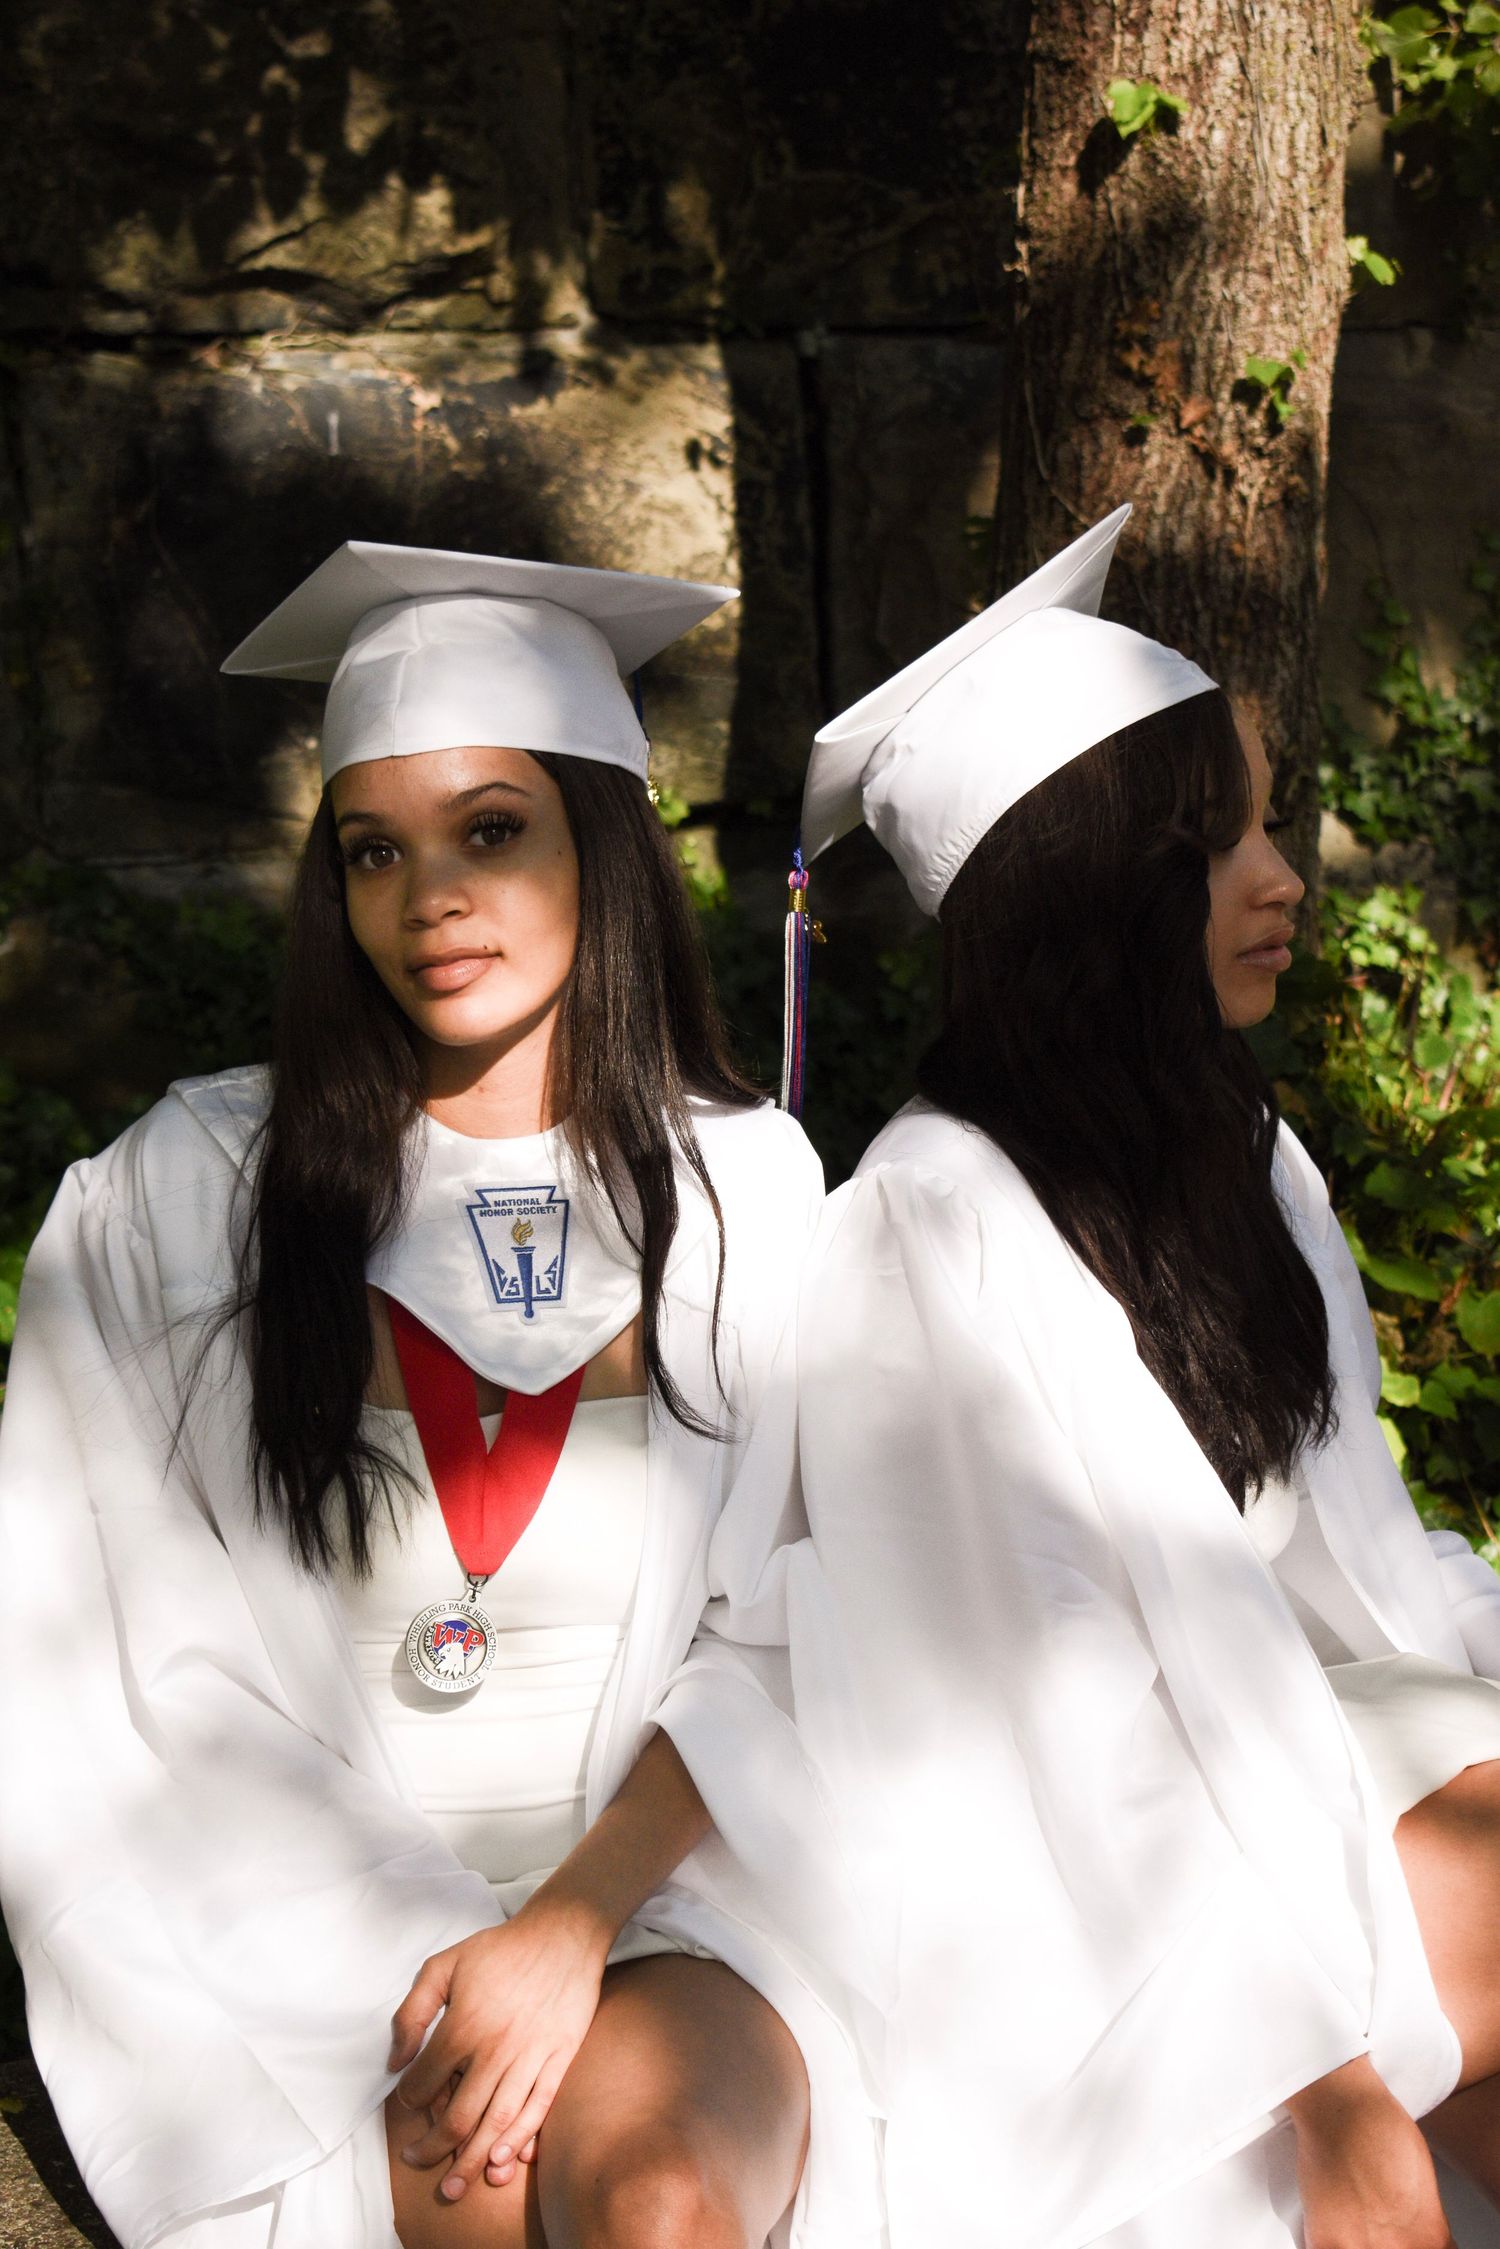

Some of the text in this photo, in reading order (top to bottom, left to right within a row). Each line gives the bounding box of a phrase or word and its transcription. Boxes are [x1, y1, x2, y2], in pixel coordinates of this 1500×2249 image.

[479, 1206, 557, 1217] HONOR SOCIETY
[494, 1198, 541, 1207] NATIONAL
[409, 1603, 497, 1670] WHEELING PARK HIGH SCHOOL
[432, 1622, 486, 1653] WP
[408, 1648, 481, 1690] HONOR STUDENT
